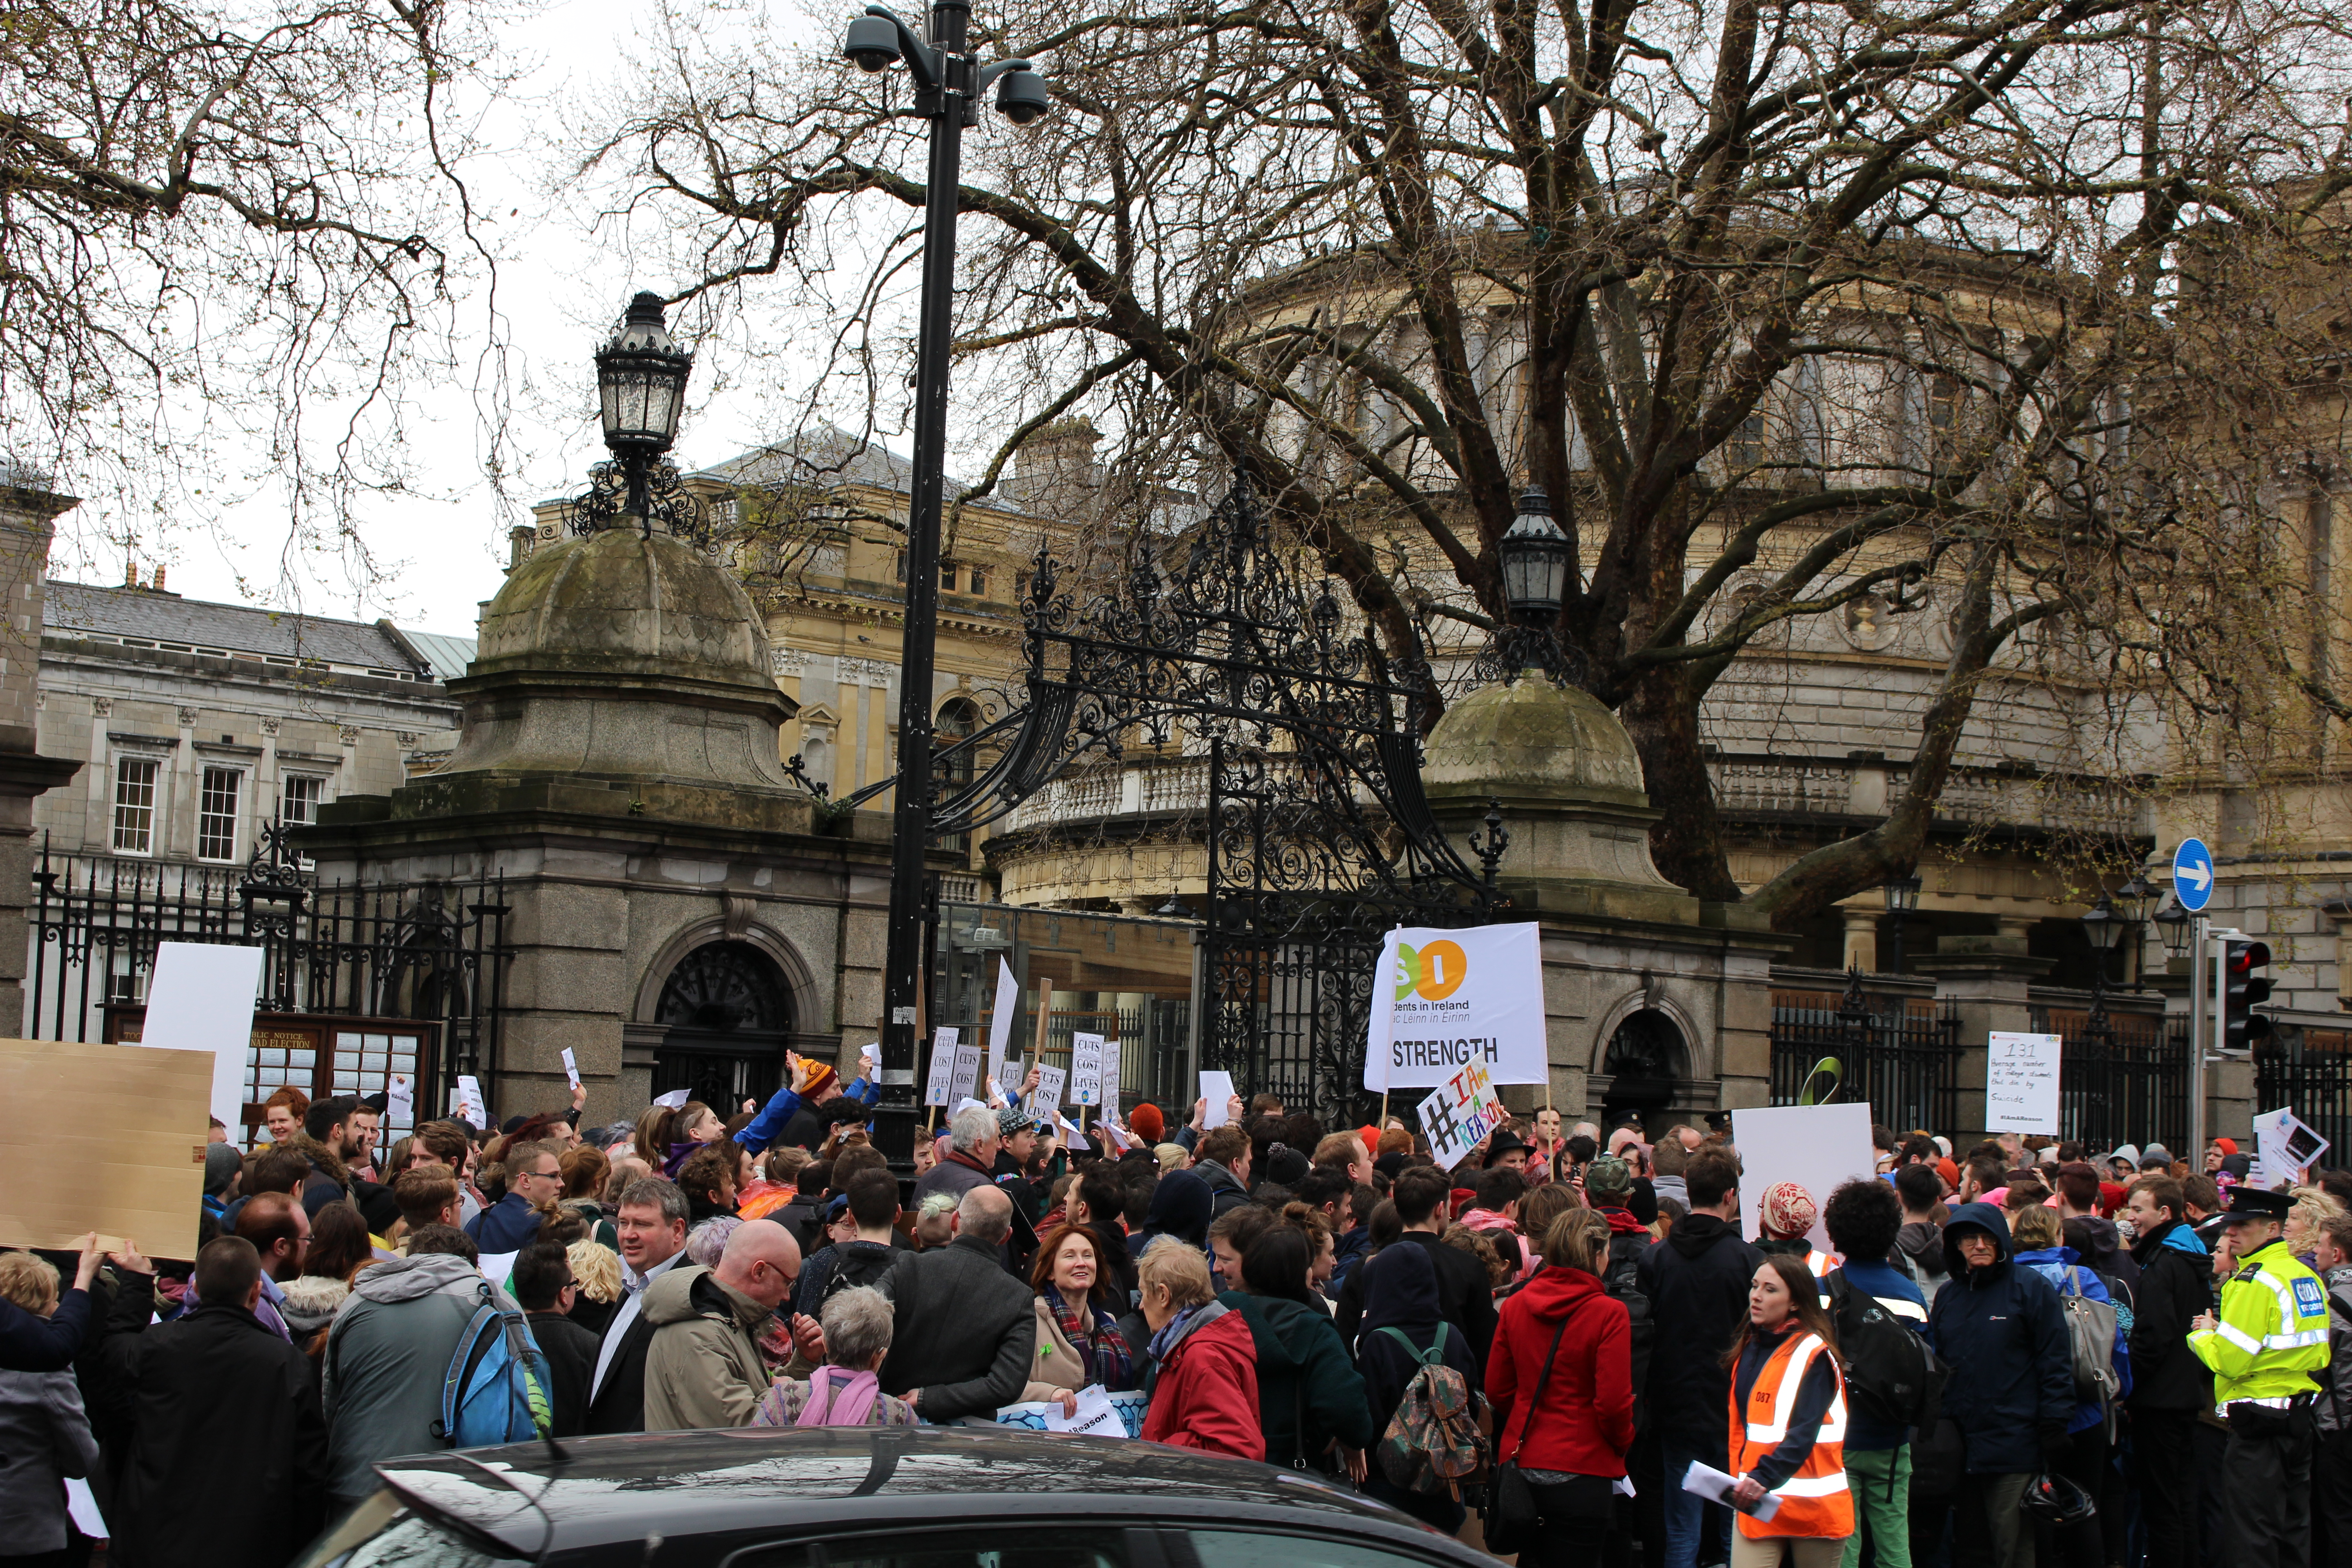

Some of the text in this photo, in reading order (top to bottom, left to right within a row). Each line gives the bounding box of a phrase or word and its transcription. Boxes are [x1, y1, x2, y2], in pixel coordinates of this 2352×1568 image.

[1420, 1001, 1428, 1011] in
[1431, 1000, 1469, 1011] Ireland
[1403, 1013, 1426, 1024] Léinn
[1430, 1014, 1438, 1023] in
[1442, 1010, 1470, 1023] Éirinn
[270, 1039, 310, 1049] ELECTION
[938, 1035, 954, 1047] CUTS
[1078, 1040, 1100, 1052] CUTS
[1393, 1038, 1498, 1067] STRENGTH
[2004, 1044, 2035, 1057] 131
[935, 1056, 951, 1068] COST
[960, 1053, 977, 1065] CUTS
[1105, 1051, 1118, 1064] CUTS
[1077, 1058, 1098, 1071] COST
[931, 1077, 949, 1088] LIVES
[956, 1073, 974, 1085] COST
[1039, 1071, 1060, 1085] CUTS
[1074, 1078, 1098, 1090] LIVES
[1105, 1073, 1117, 1086] COST
[1034, 1088, 1057, 1103] COST
[1104, 1095, 1117, 1108] LIVES
[1990, 1093, 2024, 1103] Suicide
[1472, 1094, 1482, 1112] A
[1458, 1097, 1503, 1151] REASON
